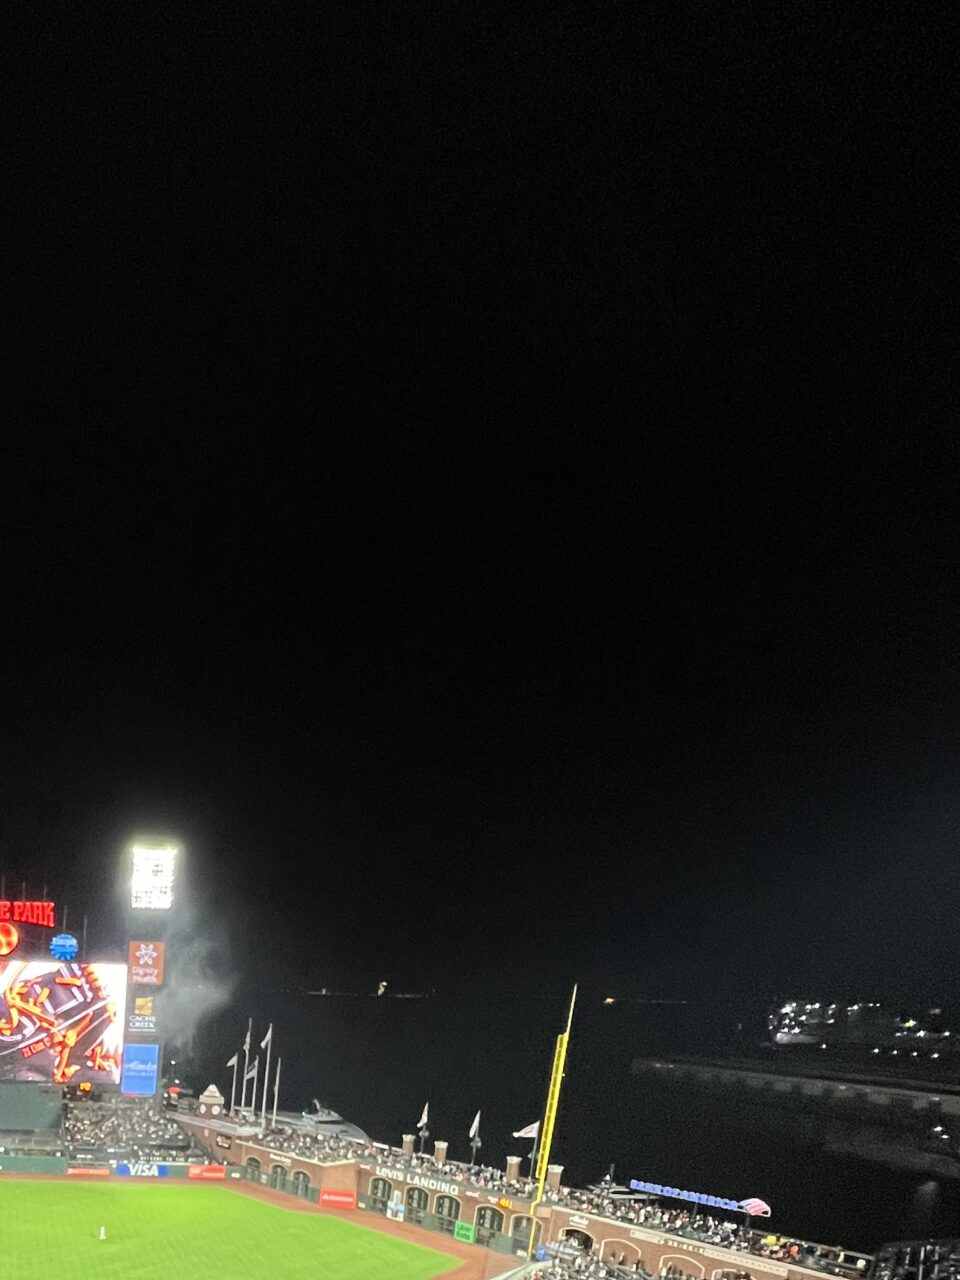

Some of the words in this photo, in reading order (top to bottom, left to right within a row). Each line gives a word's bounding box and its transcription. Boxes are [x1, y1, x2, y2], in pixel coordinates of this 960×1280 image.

[13, 901, 55, 928] PARK
[127, 1163, 159, 1177] VISA
[406, 1173, 459, 1196] LANDING
